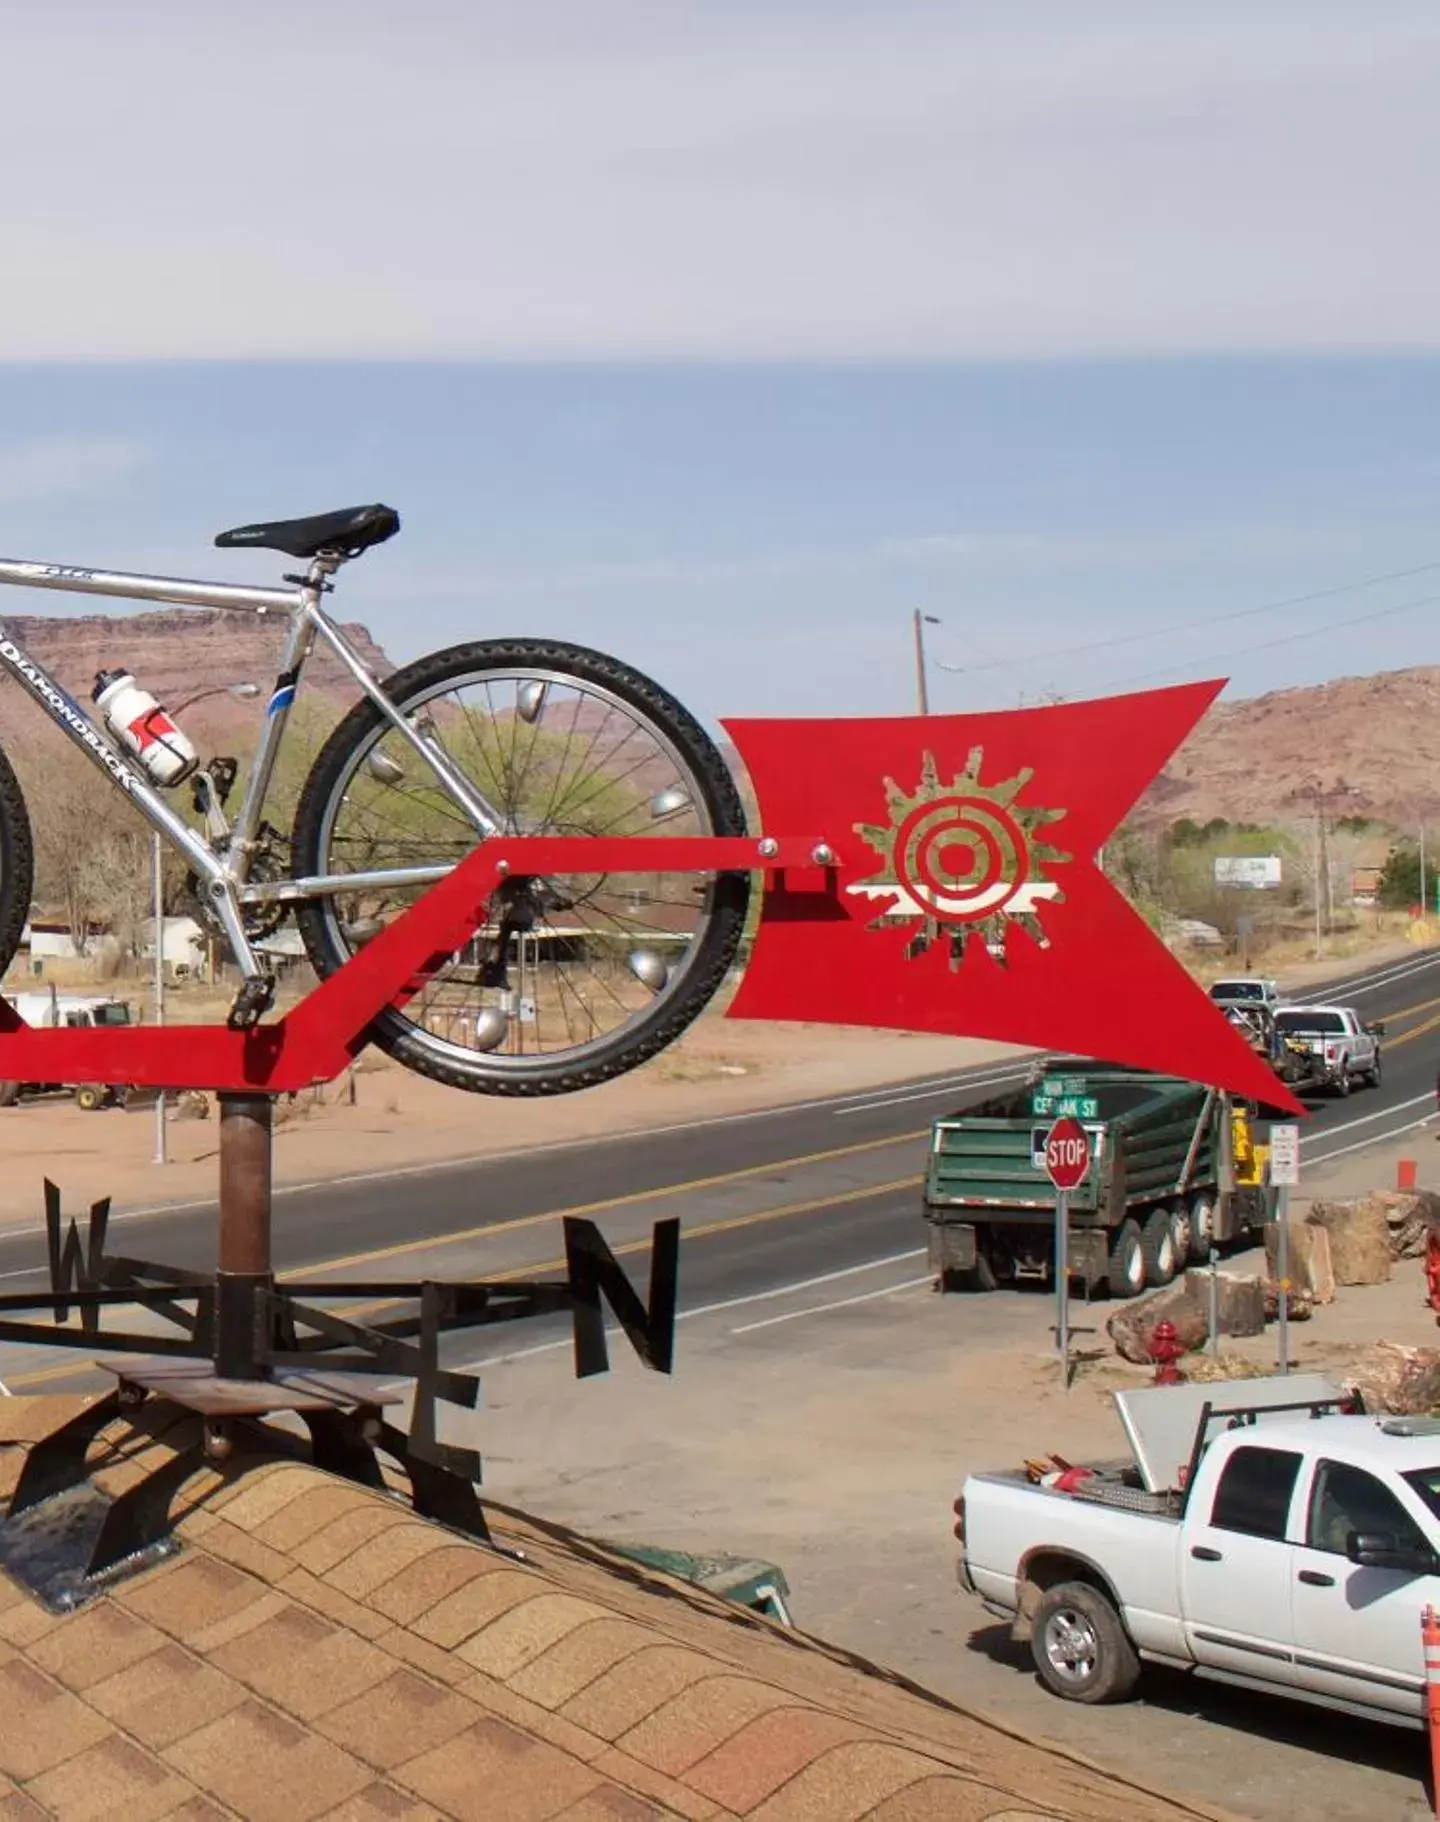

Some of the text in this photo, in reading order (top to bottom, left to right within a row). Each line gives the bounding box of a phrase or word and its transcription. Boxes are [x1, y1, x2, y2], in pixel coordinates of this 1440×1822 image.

[1081, 1099, 1097, 1118] ST
[1049, 1139, 1086, 1168] STOP
[563, 1216, 680, 1379] N
